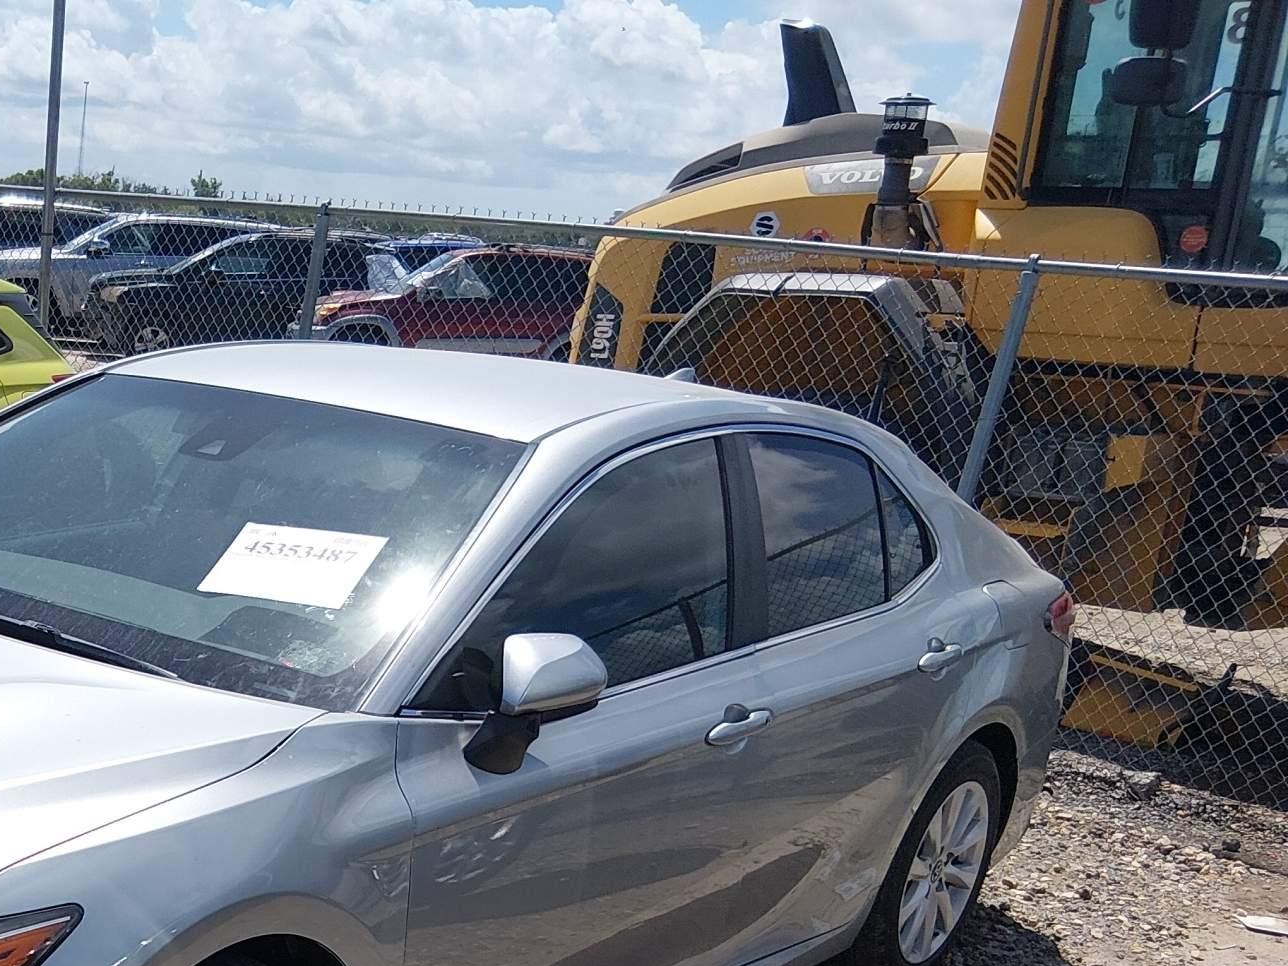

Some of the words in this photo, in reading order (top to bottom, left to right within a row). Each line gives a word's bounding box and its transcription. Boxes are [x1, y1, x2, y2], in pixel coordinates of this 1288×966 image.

[820, 167, 925, 185] VOLO
[590, 313, 616, 359] L90H
[244, 540, 359, 564] 45353487
